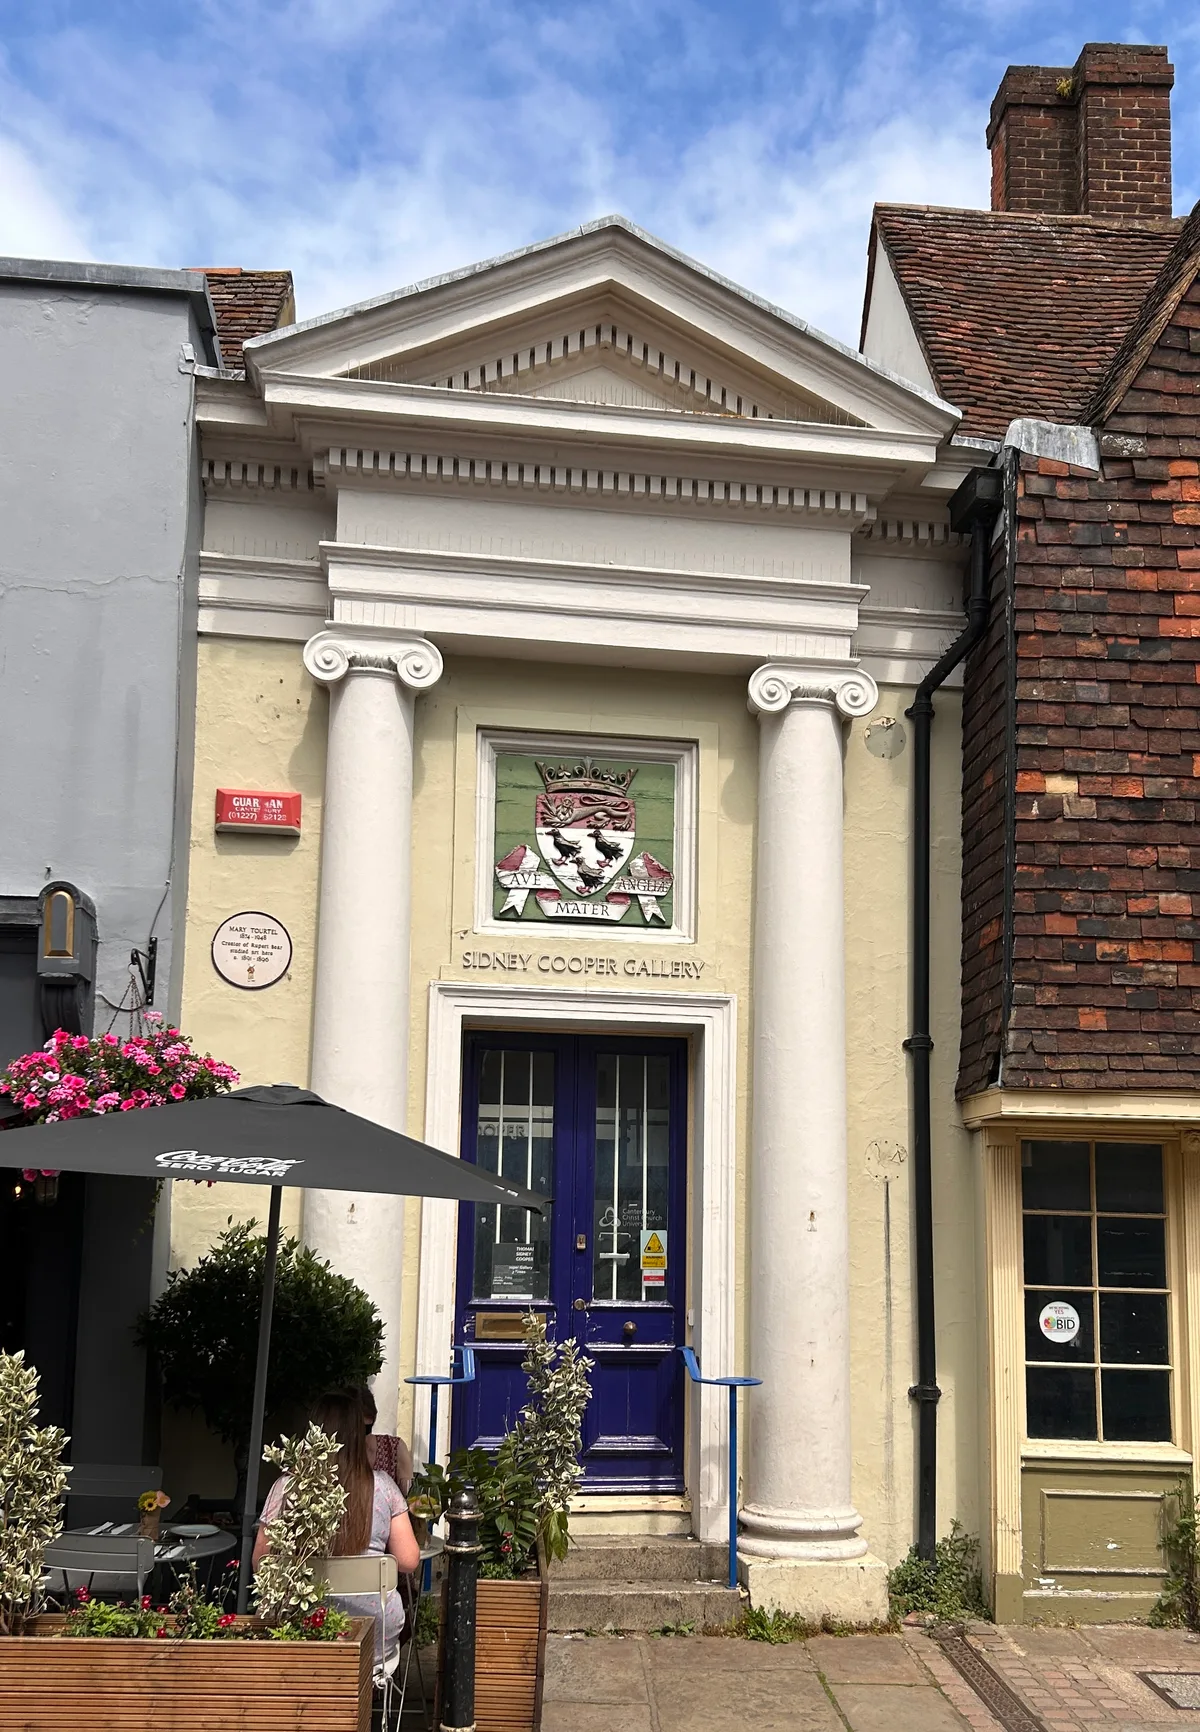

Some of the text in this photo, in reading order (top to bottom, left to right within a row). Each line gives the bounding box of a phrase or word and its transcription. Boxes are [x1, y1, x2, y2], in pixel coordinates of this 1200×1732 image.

[228, 812, 258, 820] (01227)
[509, 872, 542, 887] AVE
[554, 902, 610, 917] MATER
[462, 950, 706, 980] SIDNEY COOPER GALLERY
[155, 1150, 306, 1172] Coca-Cola
[156, 1162, 286, 1177] ZERO SUGAR
[1056, 1319, 1075, 1329] BID
